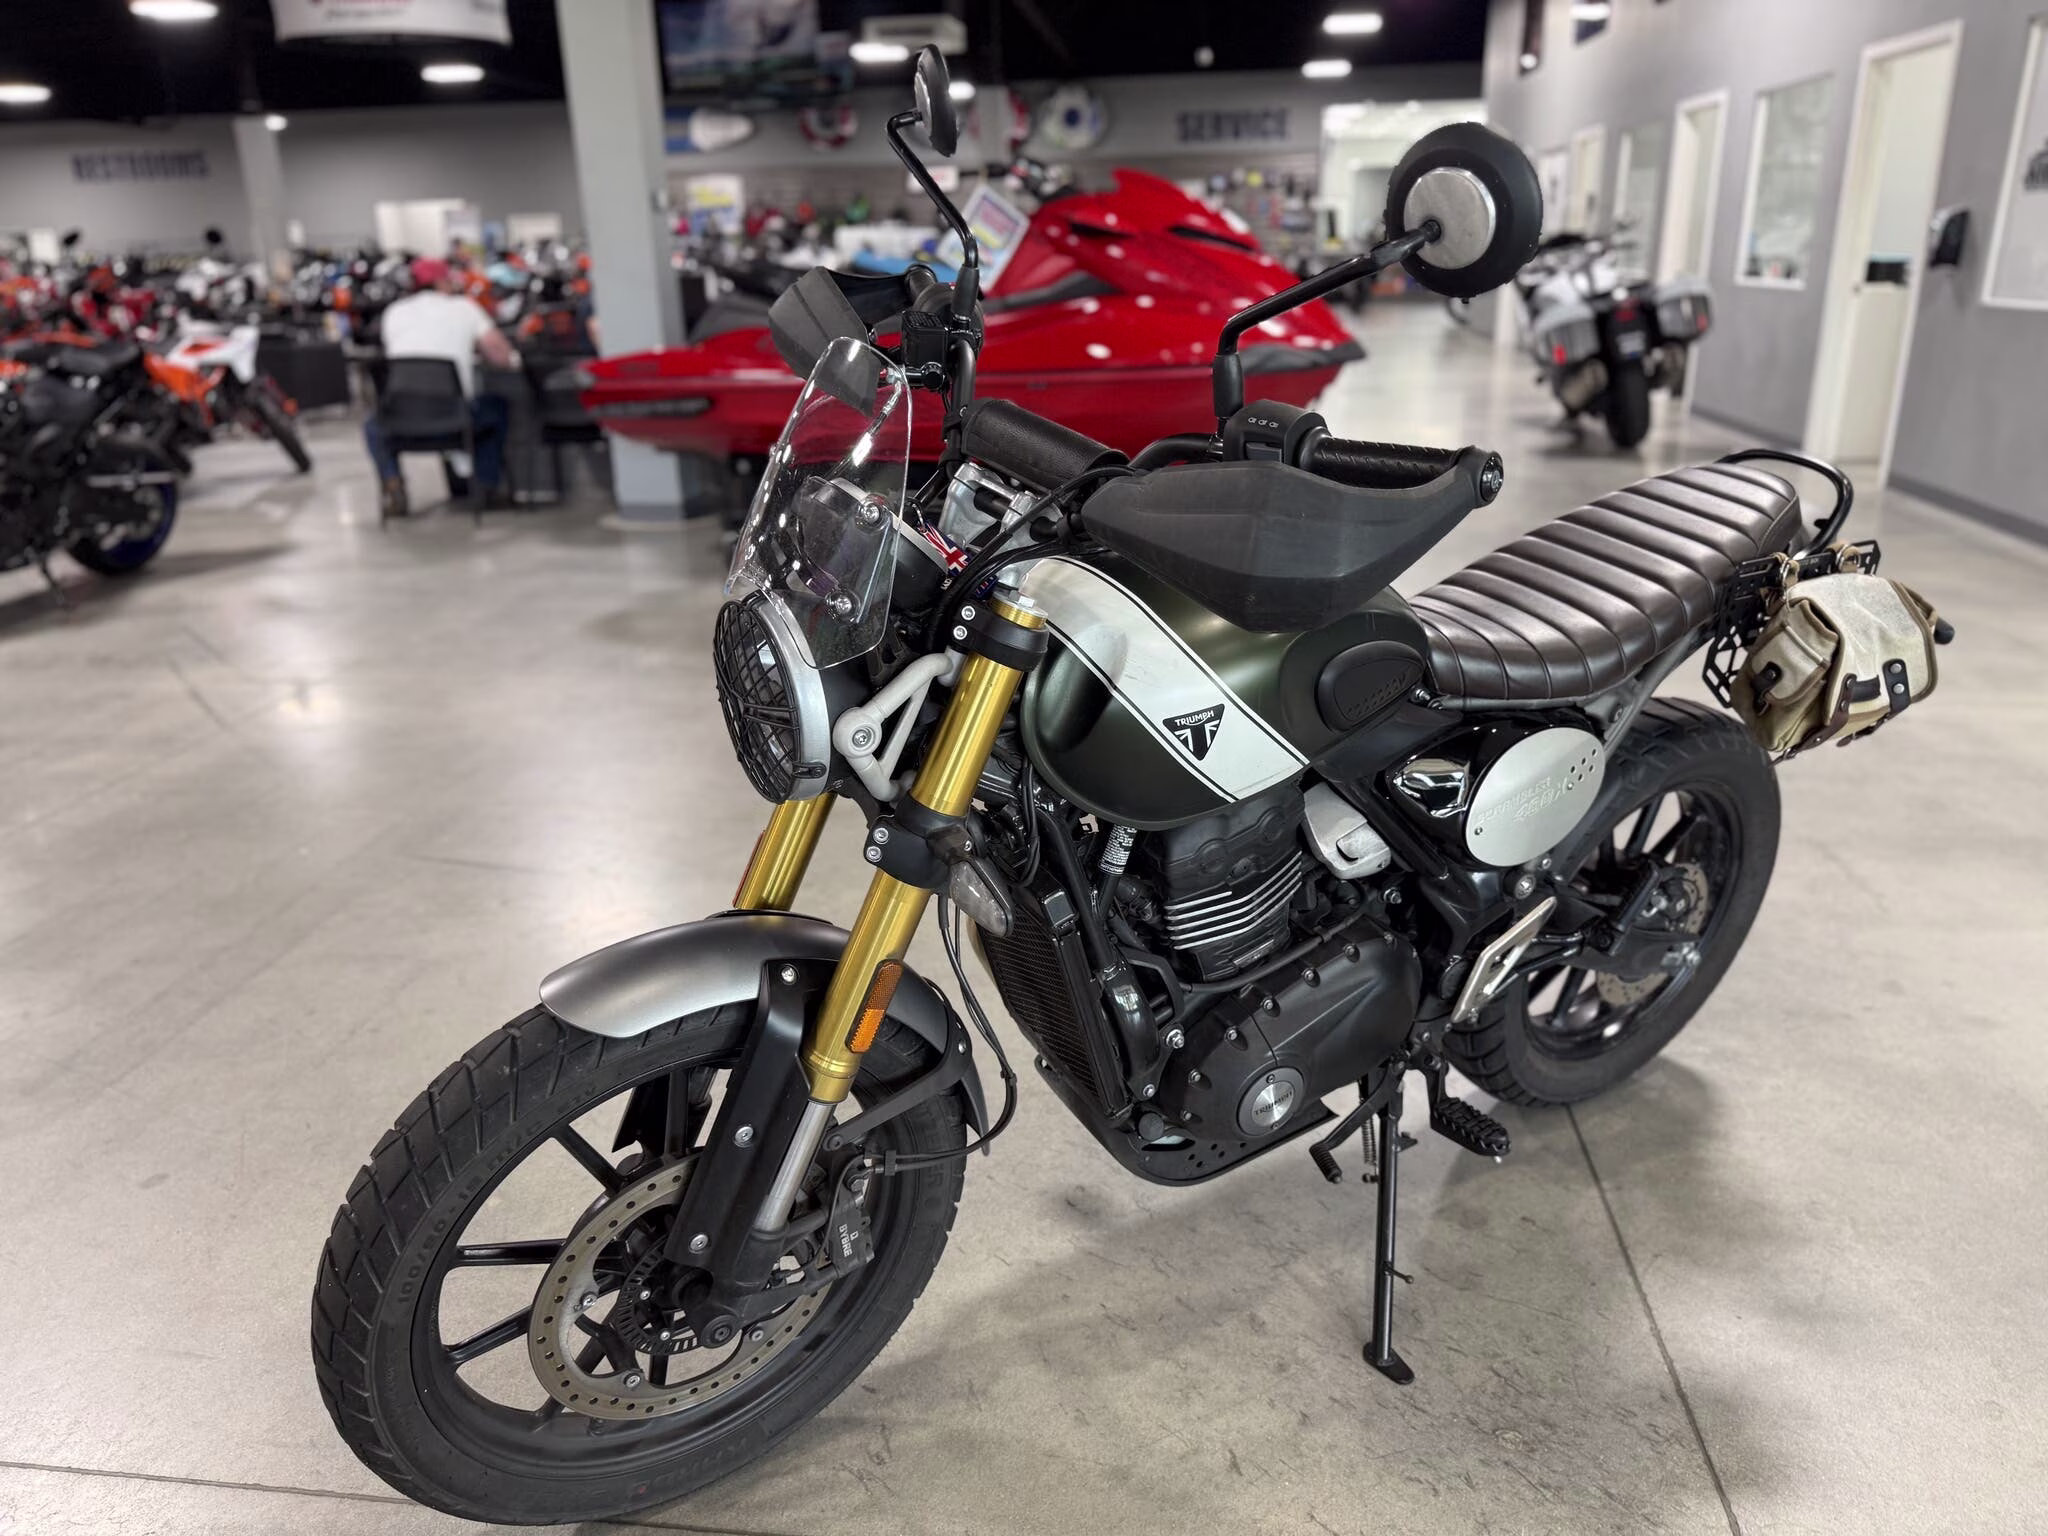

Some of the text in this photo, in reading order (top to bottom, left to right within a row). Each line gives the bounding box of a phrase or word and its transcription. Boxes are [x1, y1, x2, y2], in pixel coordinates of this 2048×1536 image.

[1177, 110, 1287, 141] SERVICE
[1174, 709, 1215, 727] TRIUMPH
[1254, 1090, 1292, 1115] TRIUMPH
[839, 1223, 853, 1258] BYBRE
